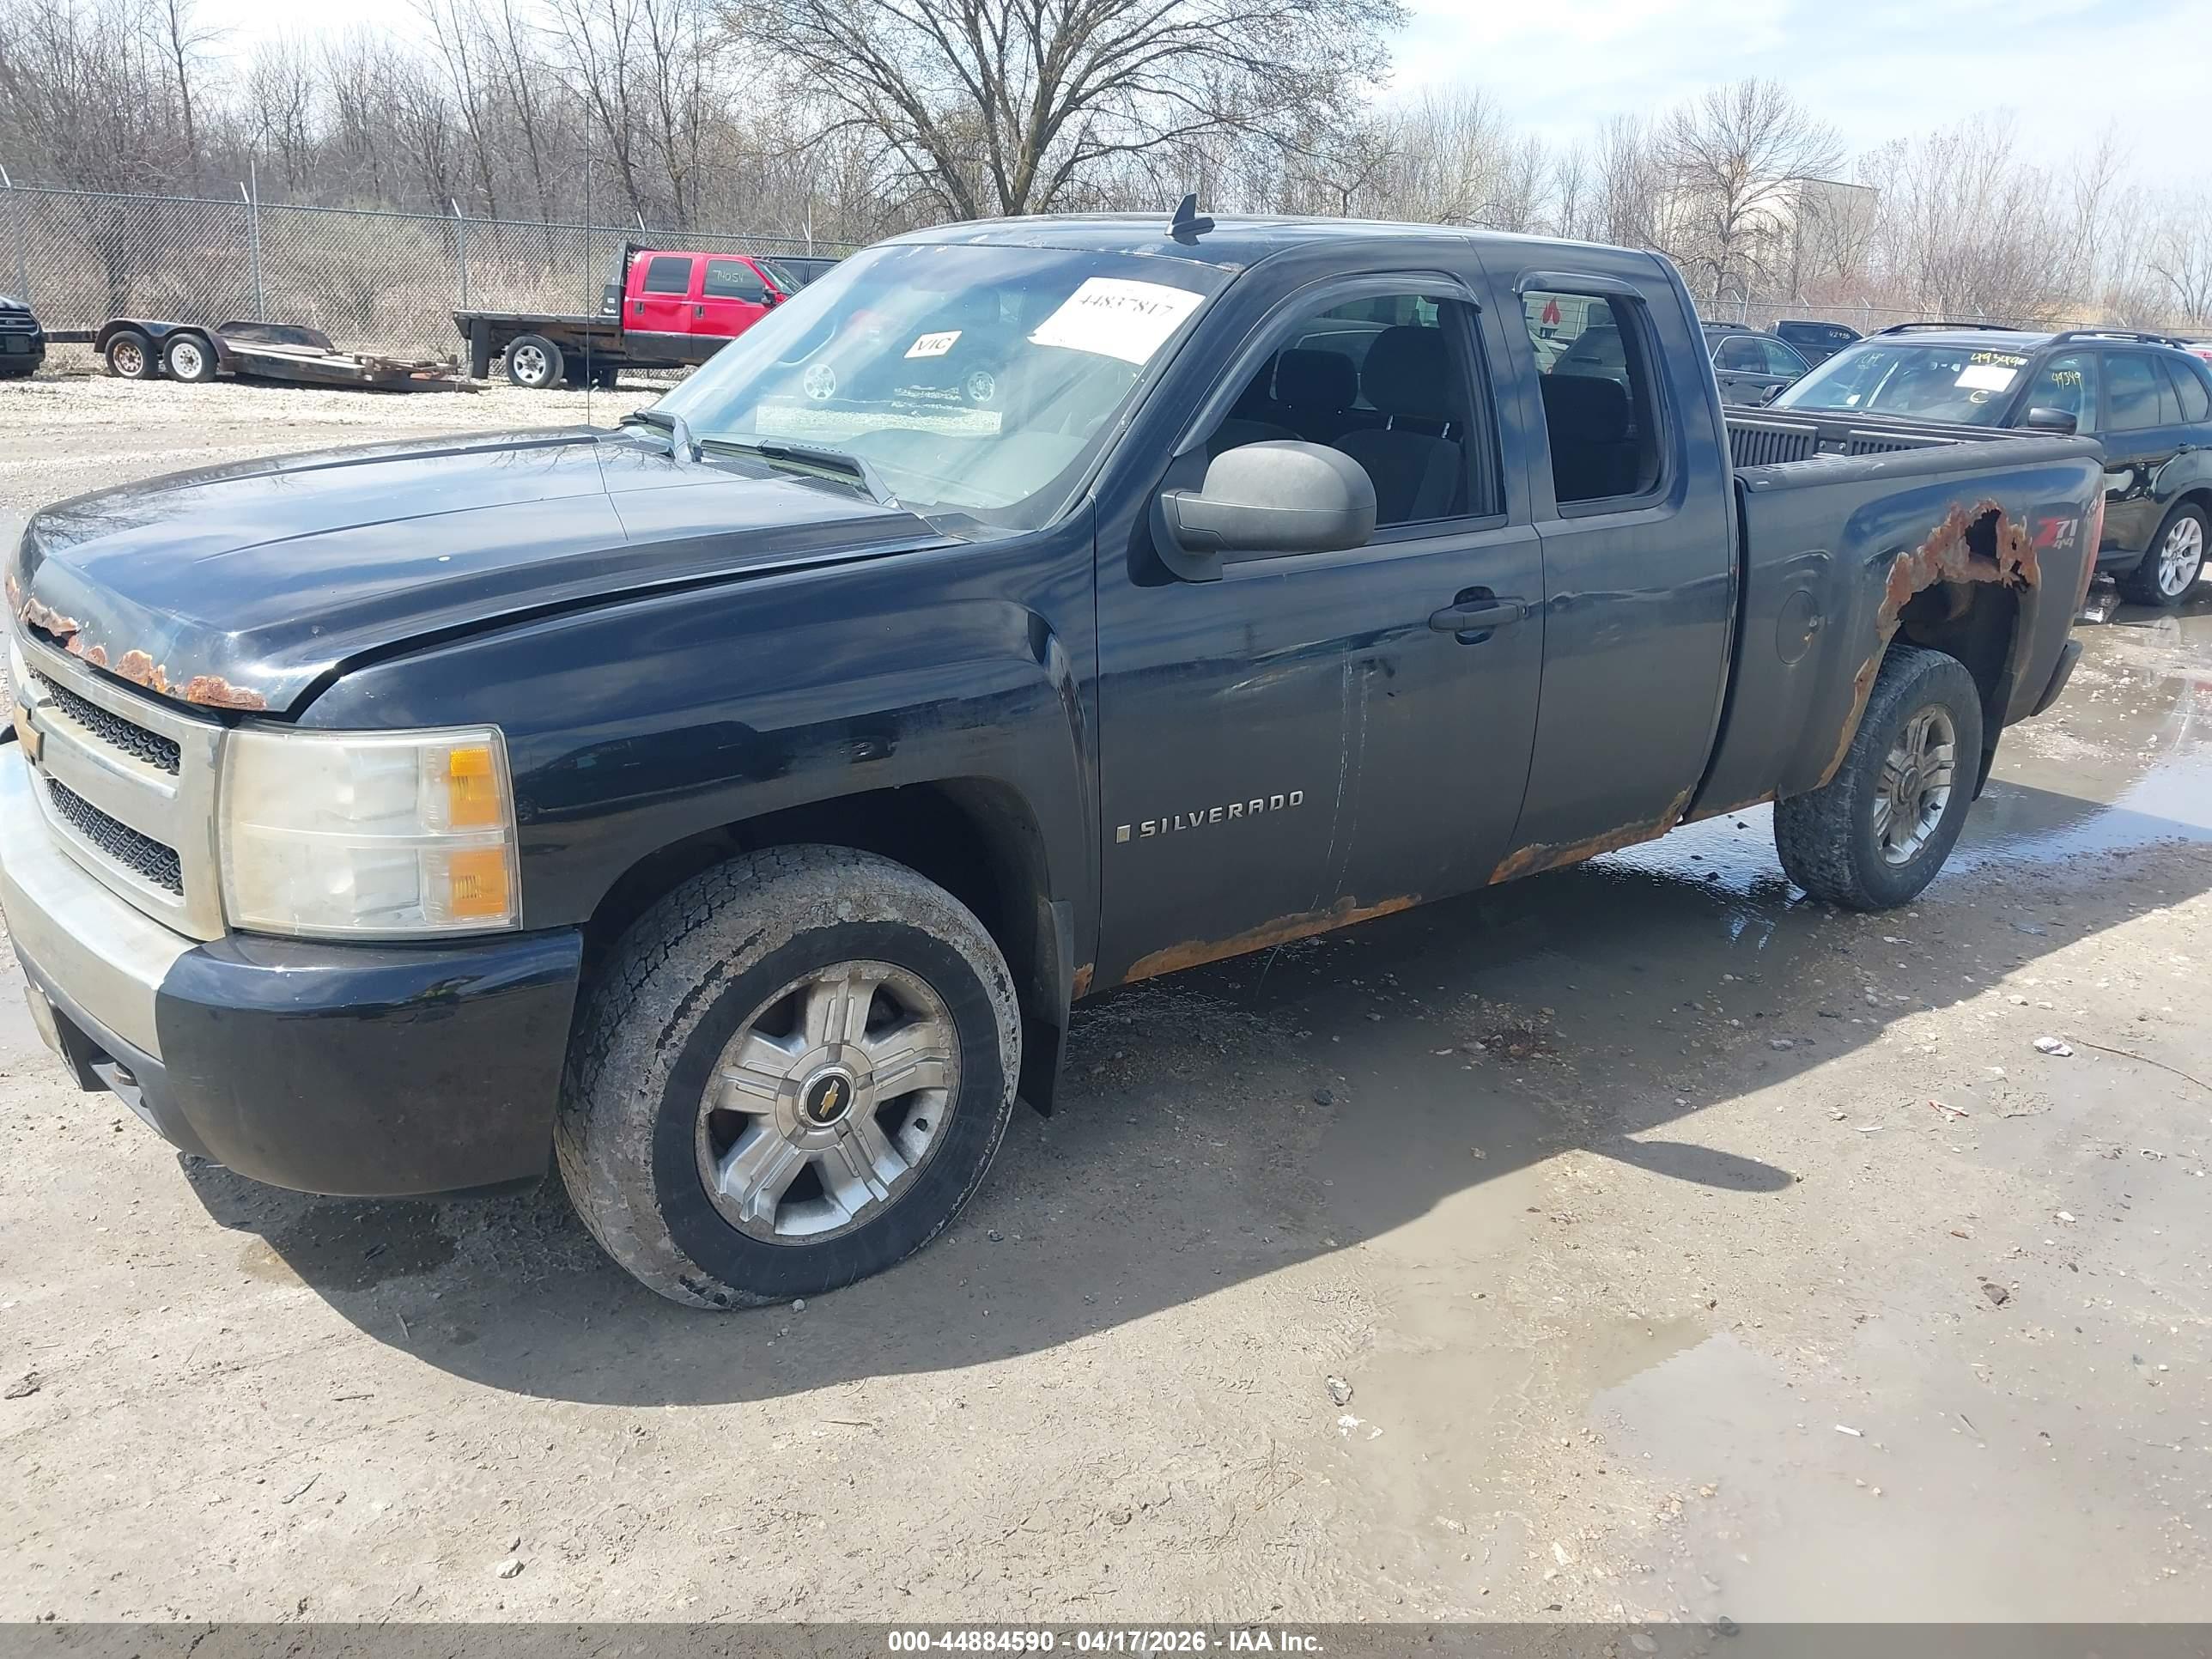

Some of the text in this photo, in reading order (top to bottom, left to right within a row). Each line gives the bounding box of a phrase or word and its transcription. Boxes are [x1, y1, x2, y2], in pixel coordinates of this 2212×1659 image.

[917, 337, 951, 350] VIC
[2033, 517, 2079, 548] Z71
[1139, 790, 1304, 839] SILVERADO
